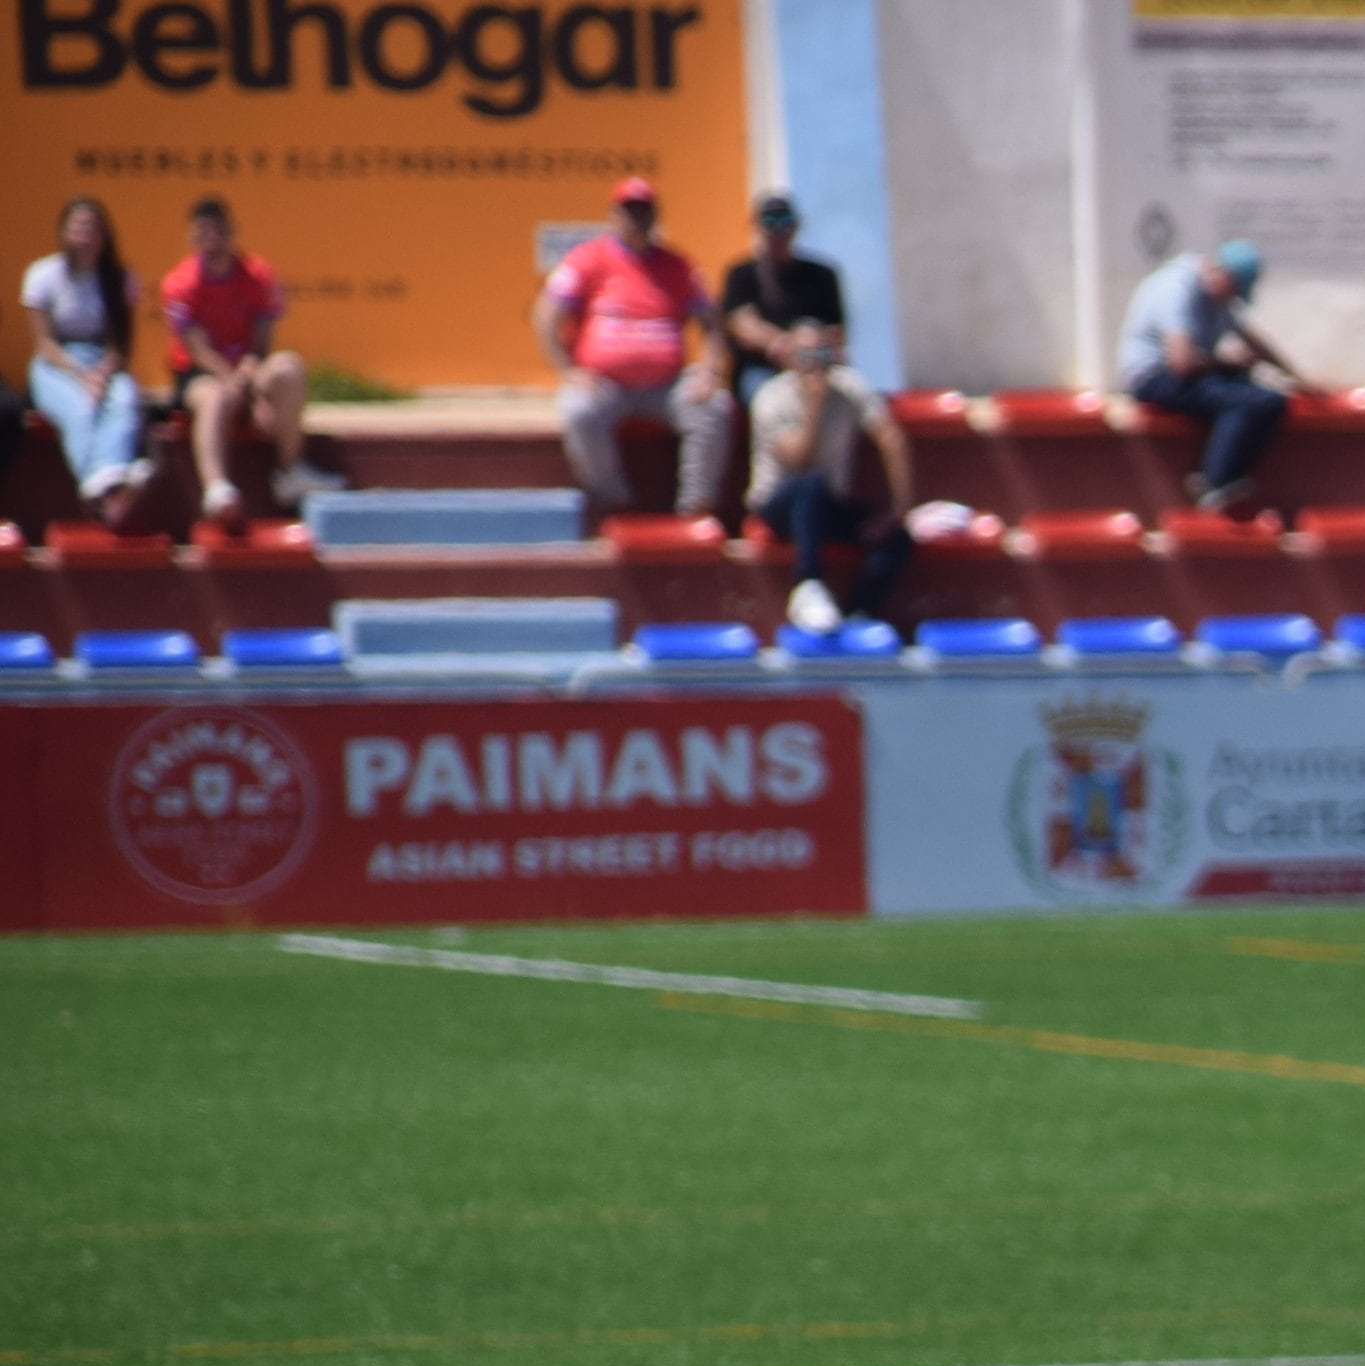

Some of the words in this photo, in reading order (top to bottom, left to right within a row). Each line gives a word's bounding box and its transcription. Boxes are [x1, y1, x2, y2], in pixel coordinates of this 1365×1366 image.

[20, 0, 705, 119] Belhogar
[345, 722, 825, 816] PAIMANS
[368, 837, 500, 882] ASIAN
[515, 831, 682, 876] STREET
[692, 828, 812, 871] FOOD
